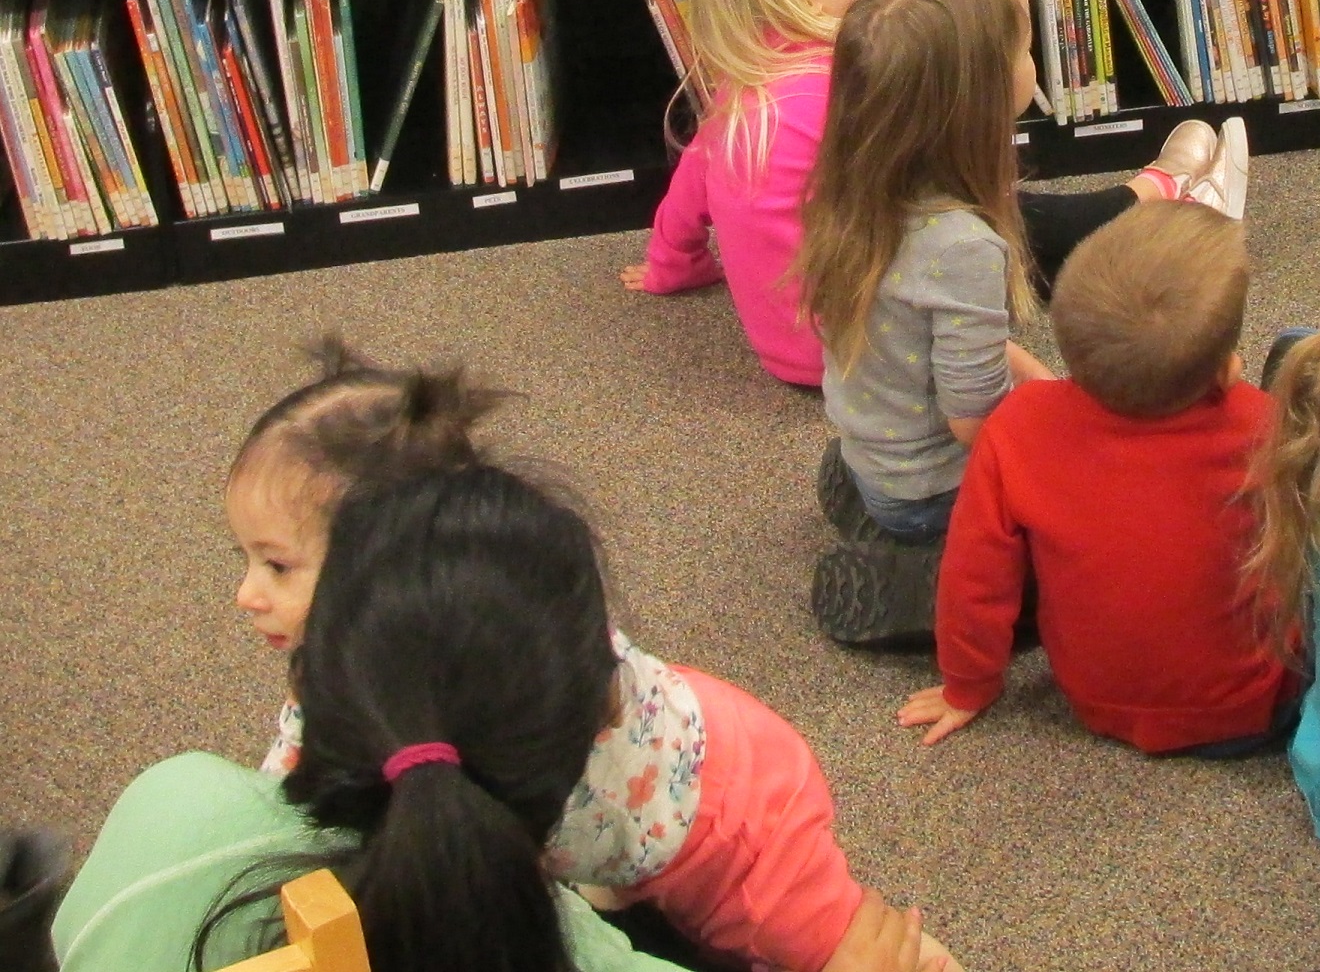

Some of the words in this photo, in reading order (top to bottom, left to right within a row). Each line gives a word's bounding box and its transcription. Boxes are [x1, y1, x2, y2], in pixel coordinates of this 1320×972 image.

[1093, 123, 1128, 131] MONSTERS
[568, 174, 620, 185] CELEBRATIONS
[351, 208, 406, 219] GRANDPARENTS
